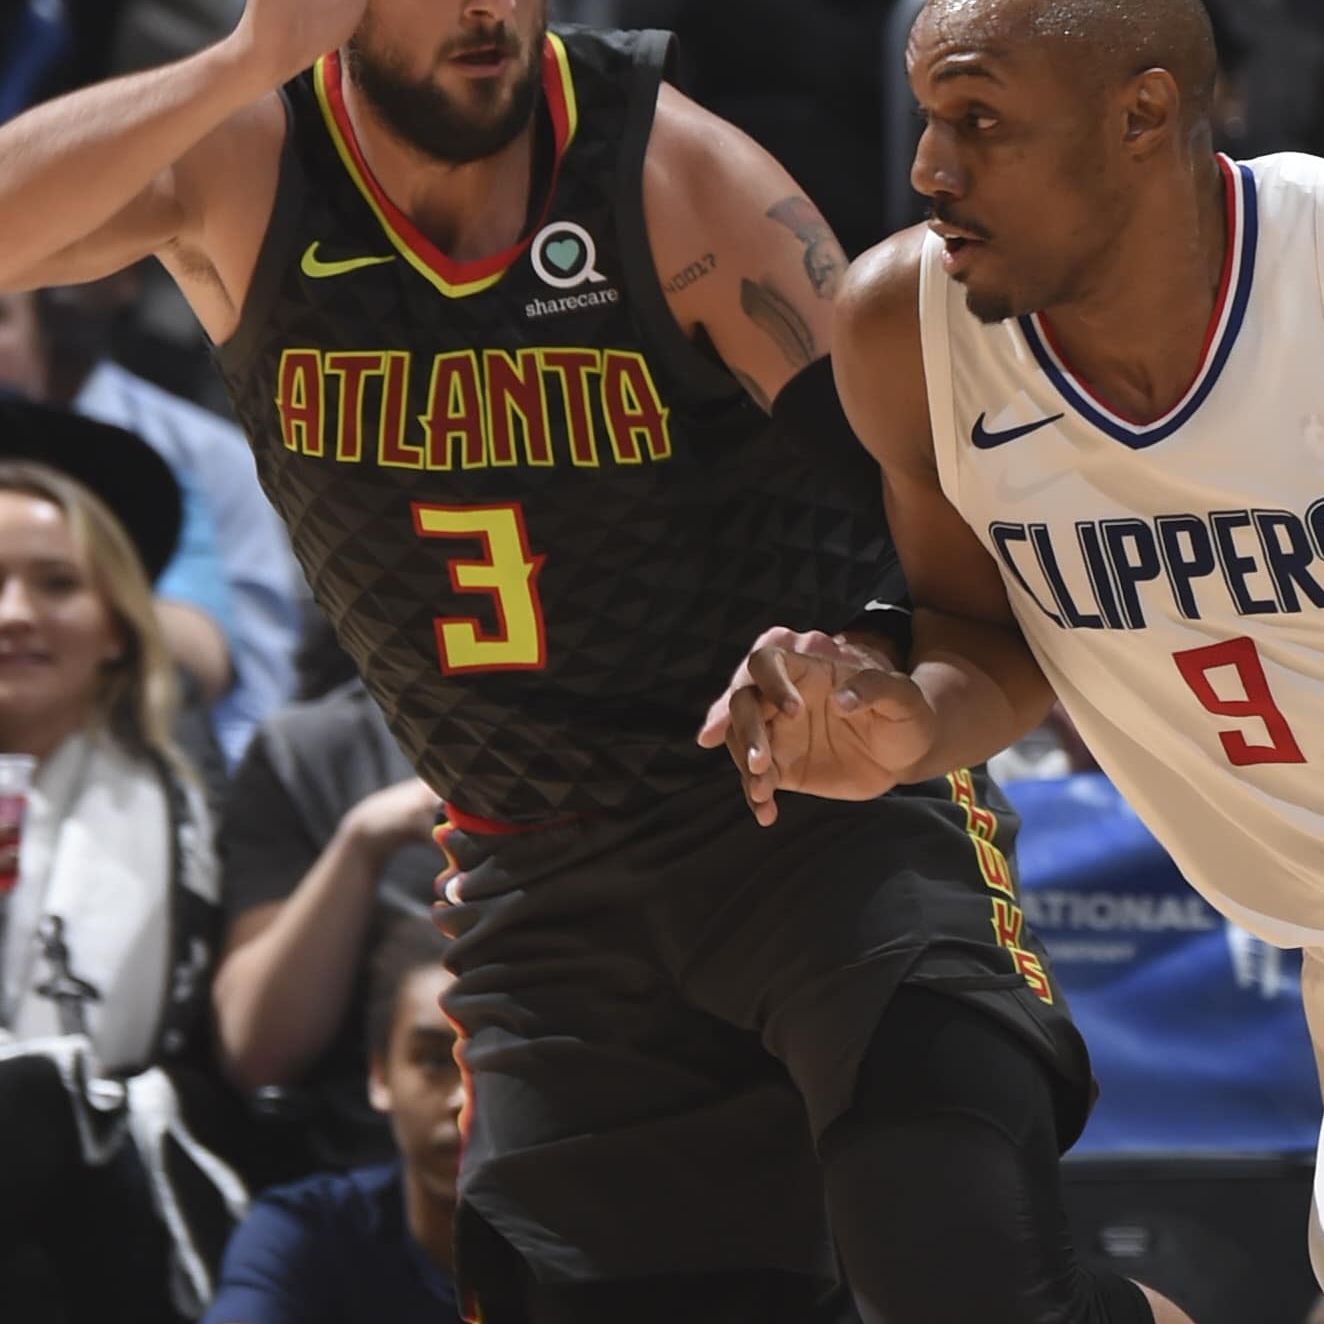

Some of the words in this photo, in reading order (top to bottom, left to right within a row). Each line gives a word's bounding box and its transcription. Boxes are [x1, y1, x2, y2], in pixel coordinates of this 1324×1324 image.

[525, 287, 619, 317] sharecare
[275, 347, 671, 471] ATLANTA
[411, 502, 548, 676] 3
[1172, 636, 1307, 766] 9
[1021, 889, 1214, 932] ATIONAL
